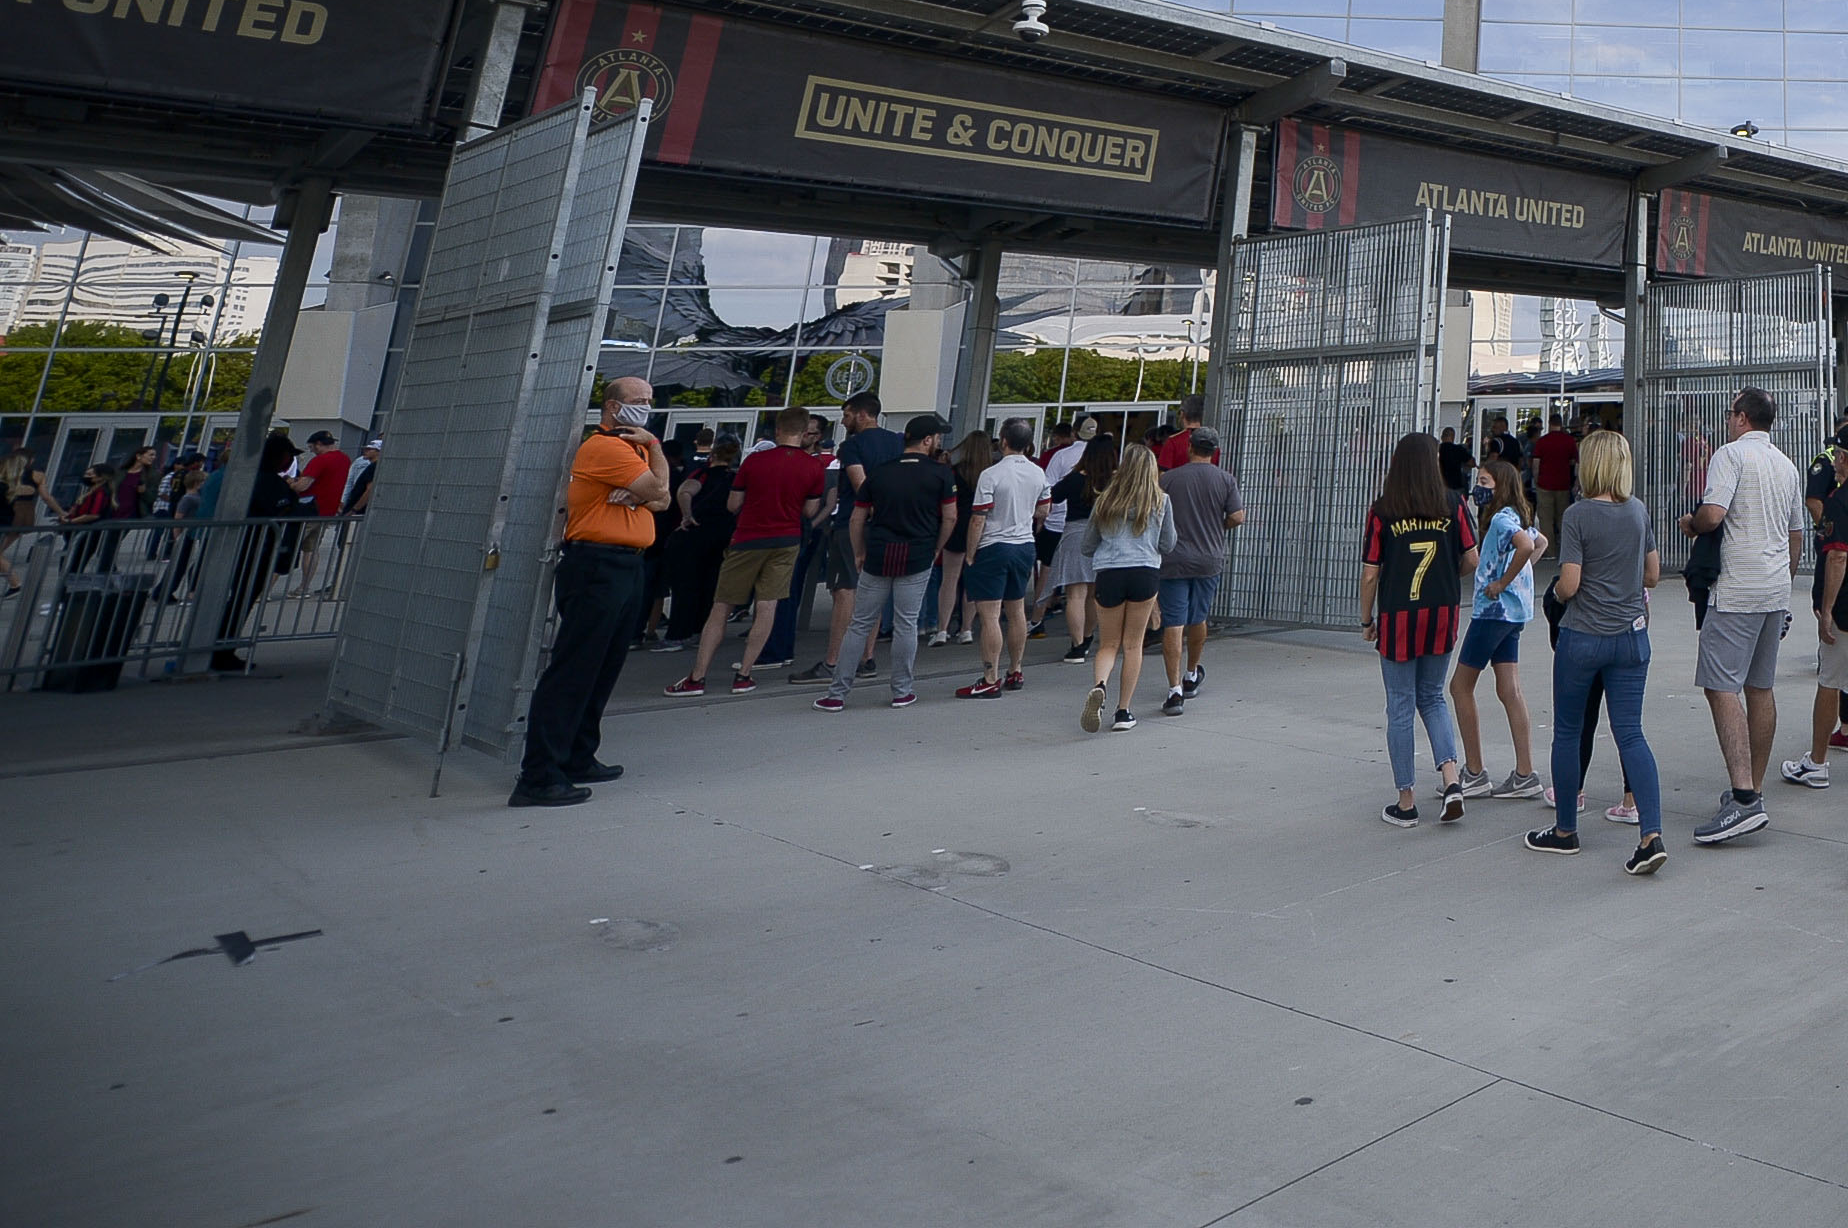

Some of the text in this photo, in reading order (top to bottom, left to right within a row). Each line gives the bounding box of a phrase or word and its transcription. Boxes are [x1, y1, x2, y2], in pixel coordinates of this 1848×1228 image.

[598, 51, 665, 76] ATLANTA
[816, 92, 1146, 169] UNITE & CONQUER
[1303, 158, 1336, 174] ATLANTA
[1296, 193, 1324, 211] UNITED
[1415, 181, 1585, 229] ATLANTA UNITED
[1742, 231, 1802, 259] ATLANTA
[1390, 516, 1452, 538] MARTINEZ
[1409, 540, 1437, 601] 7
